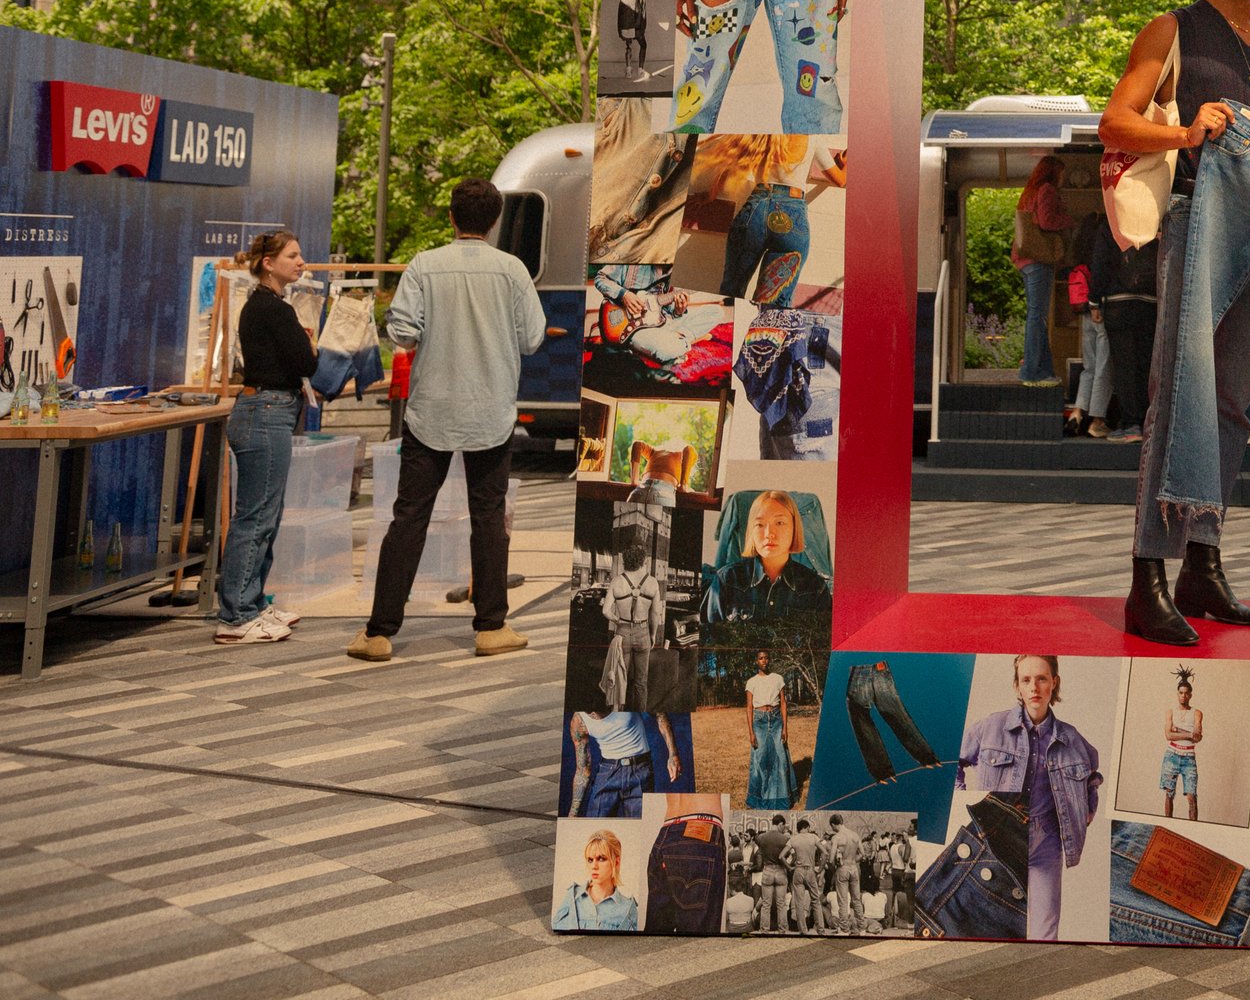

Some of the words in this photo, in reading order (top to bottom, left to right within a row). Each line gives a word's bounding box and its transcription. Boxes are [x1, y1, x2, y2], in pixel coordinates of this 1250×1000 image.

[170, 119, 209, 164] LAB
[214, 124, 246, 168] 150
[5, 228, 69, 242] DISTRESS
[205, 233, 223, 244] LAB
